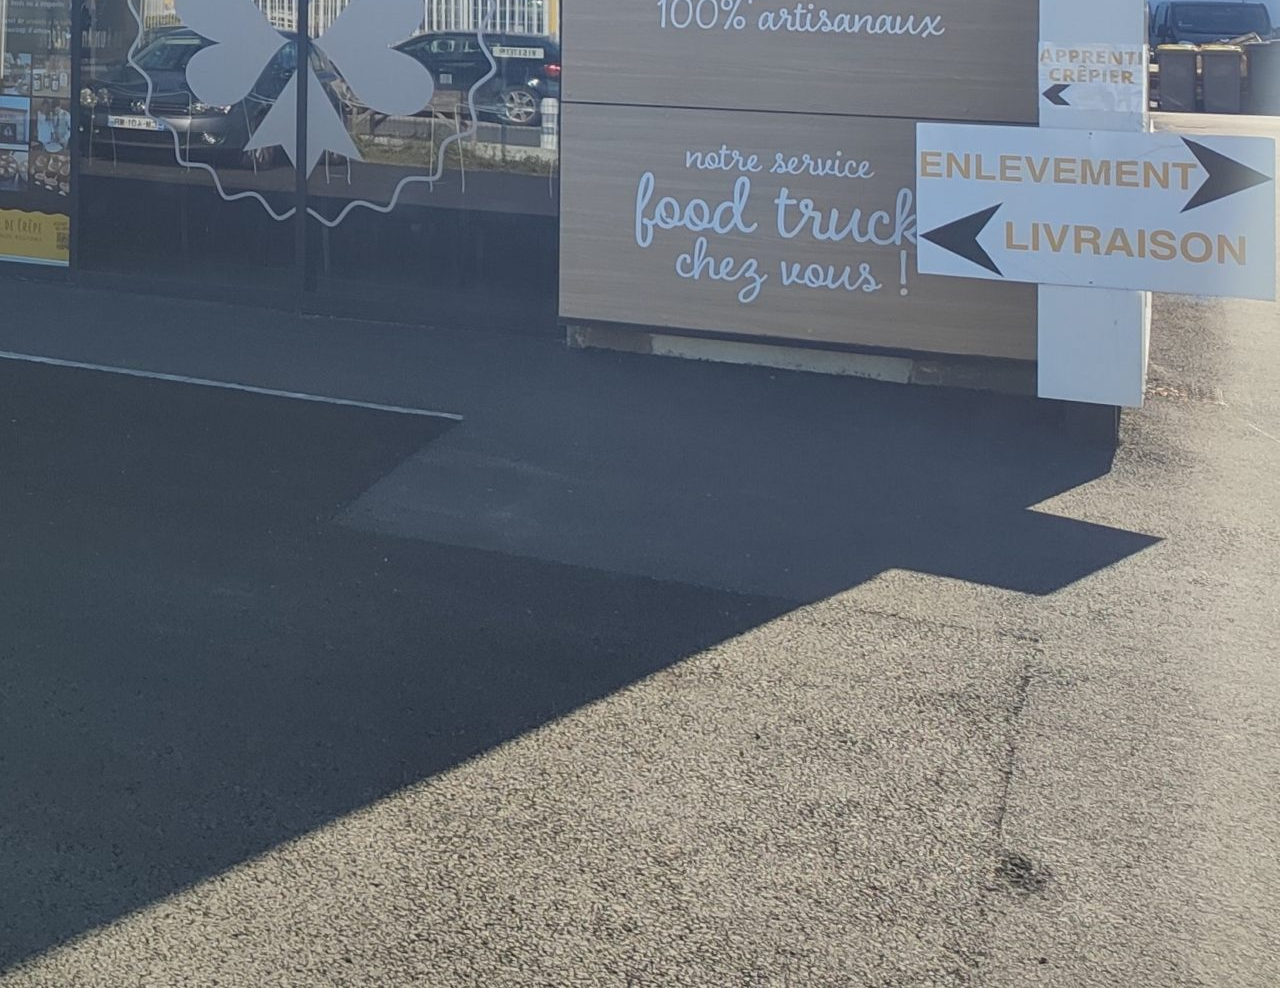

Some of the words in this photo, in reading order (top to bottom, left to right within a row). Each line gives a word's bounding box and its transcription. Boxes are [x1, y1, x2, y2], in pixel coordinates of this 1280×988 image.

[758, 3, 946, 38] artisanaux
[1039, 48, 1144, 66] APPRENTI
[1048, 65, 1134, 85] CRÊPIER
[685, 144, 764, 173] notre
[769, 150, 875, 179] service
[920, 150, 1198, 191] ENLEVEMENT
[635, 171, 758, 248] food
[774, 187, 917, 247] truck
[1005, 220, 1247, 266] LIVRAISON
[675, 236, 768, 304] chez
[780, 260, 882, 293] vous
